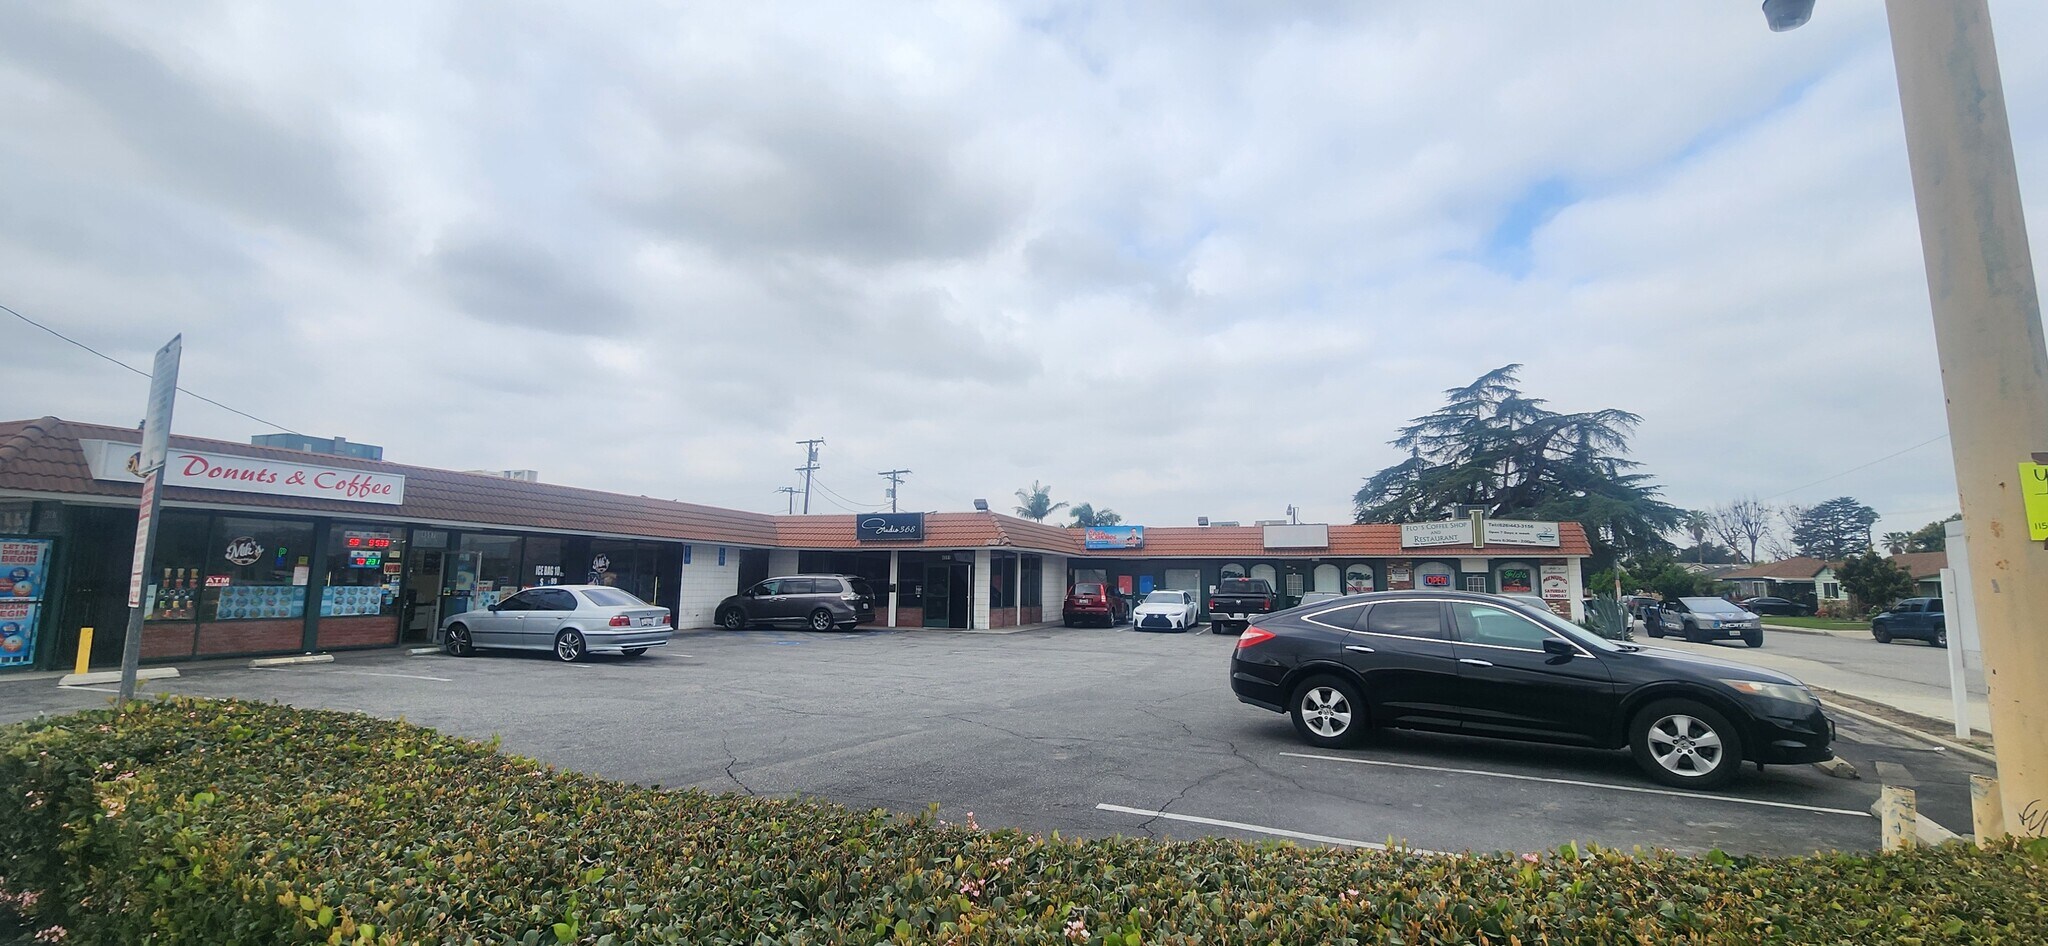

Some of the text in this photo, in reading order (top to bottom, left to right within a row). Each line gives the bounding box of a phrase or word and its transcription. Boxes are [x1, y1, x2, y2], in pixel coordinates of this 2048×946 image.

[178, 454, 392, 498] Donuts & Coffee
[1426, 576, 1447, 584] OPEN
[1543, 575, 1567, 584] MENUDO
